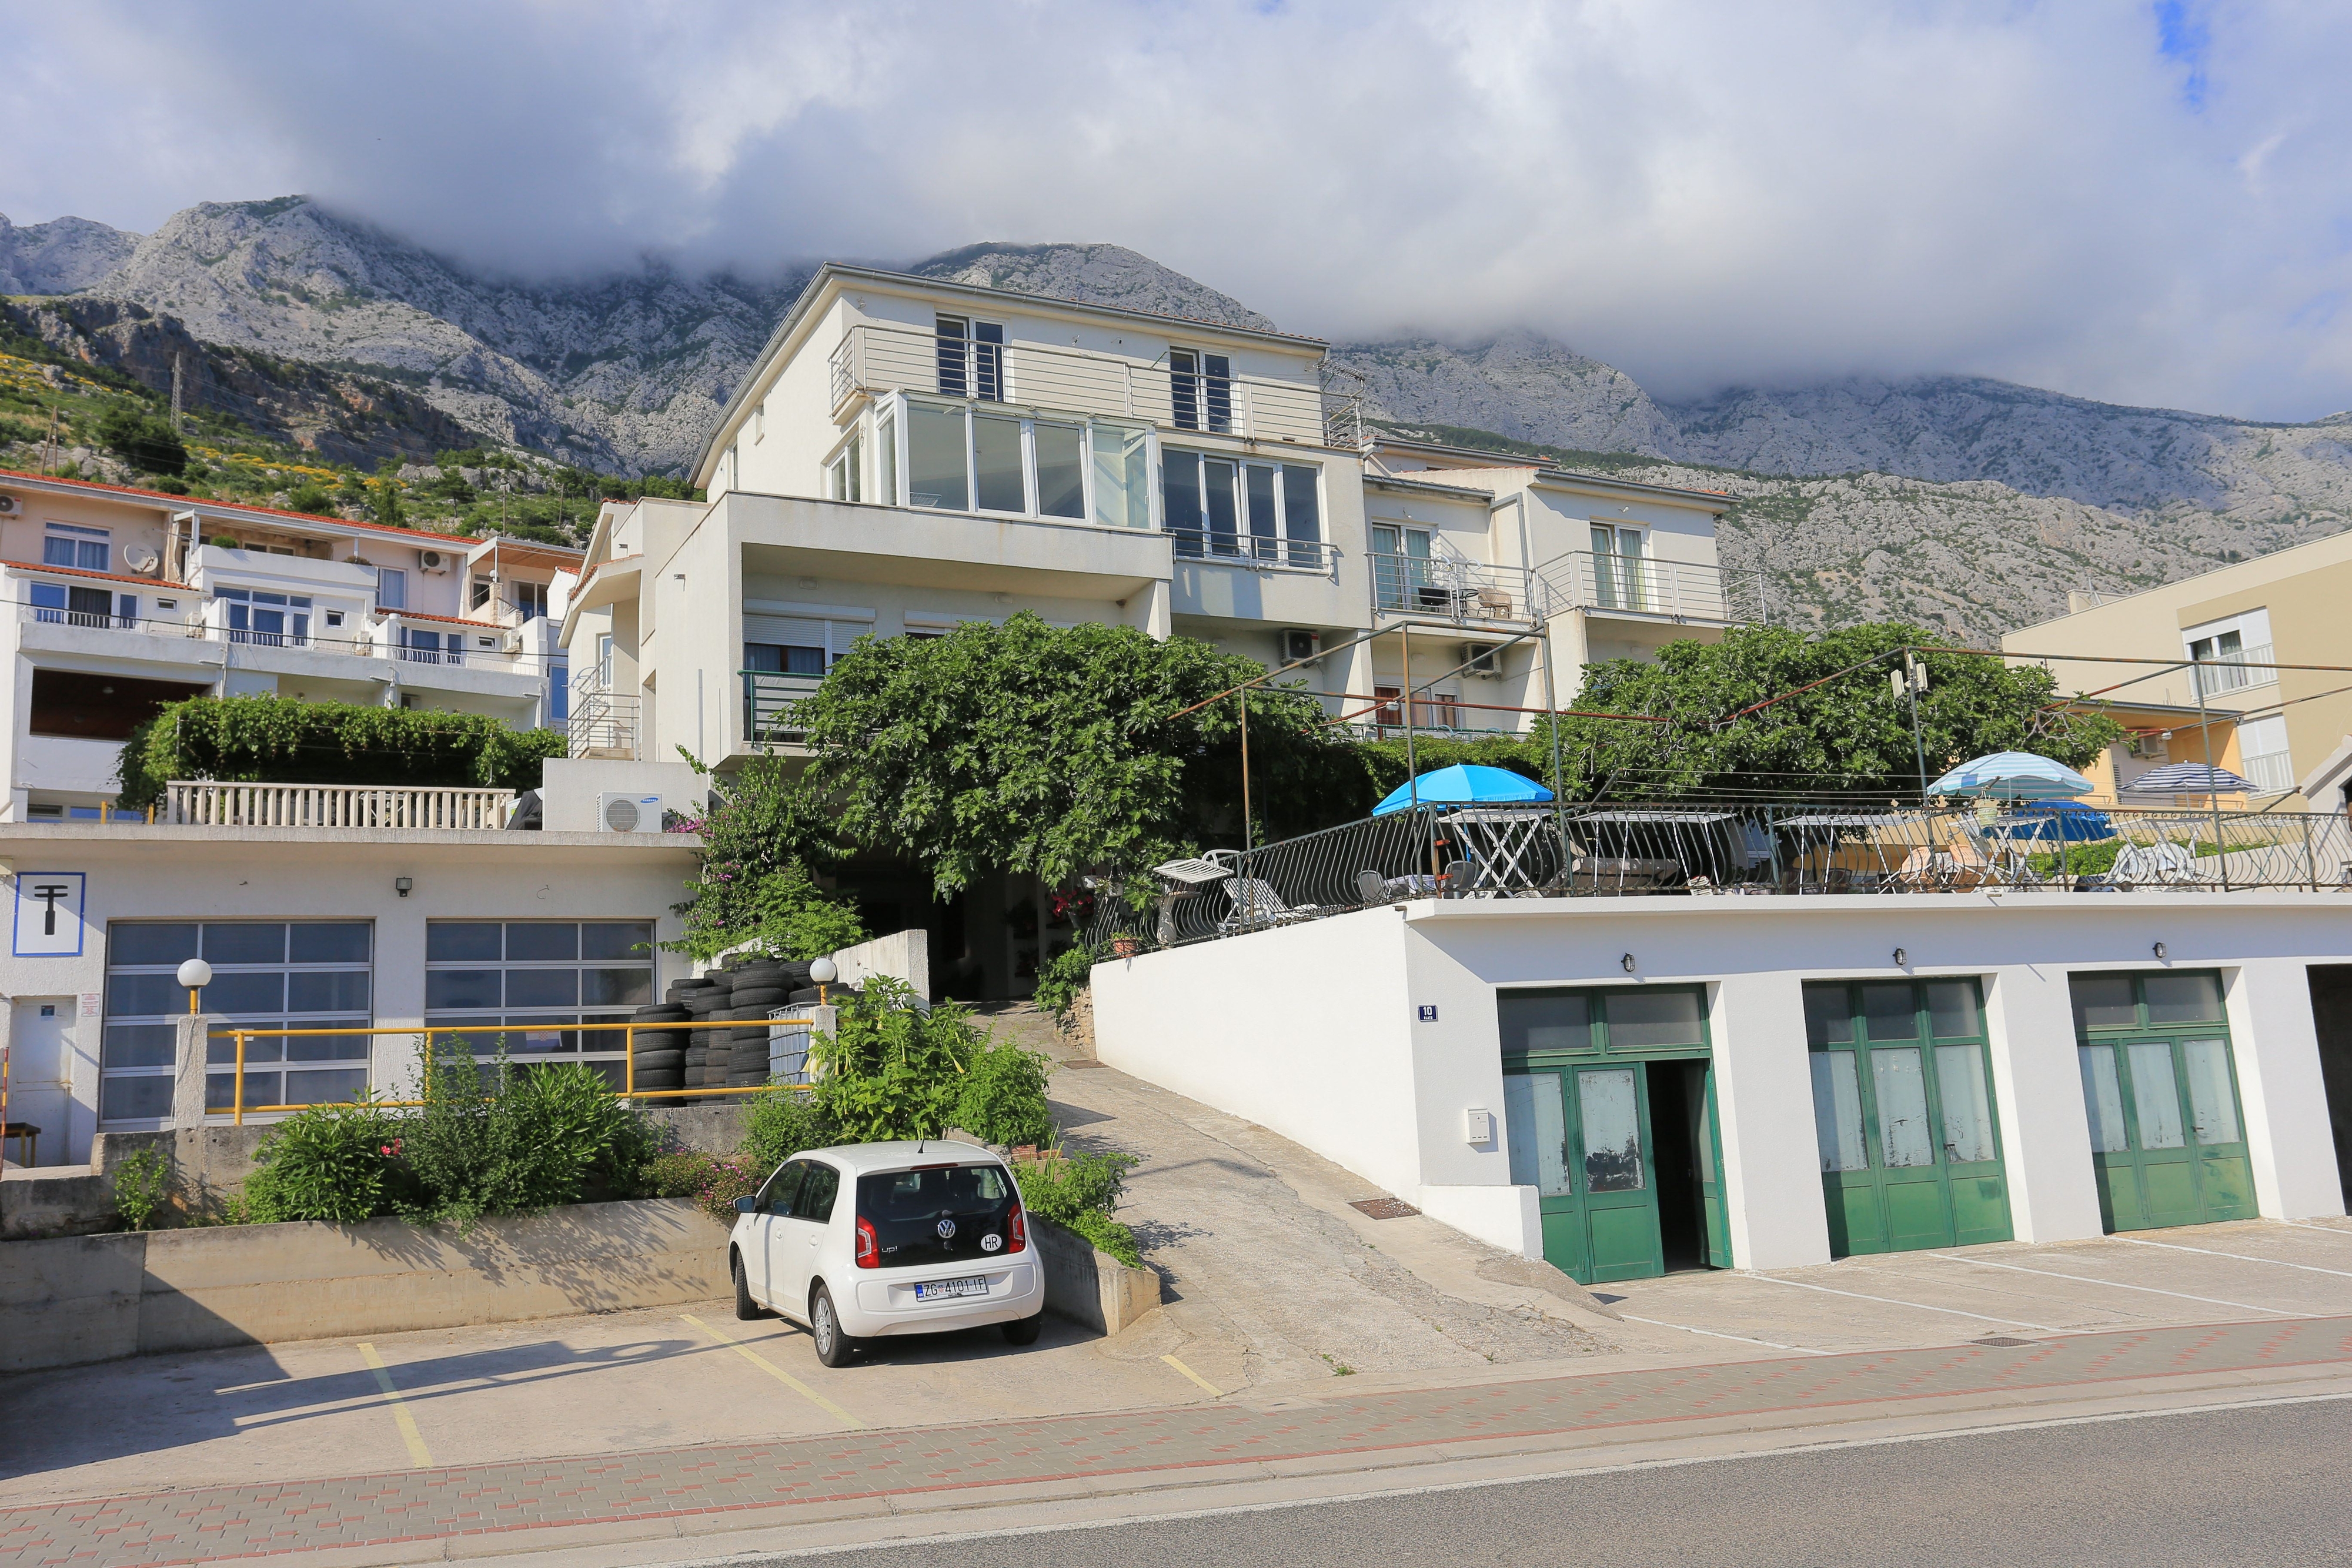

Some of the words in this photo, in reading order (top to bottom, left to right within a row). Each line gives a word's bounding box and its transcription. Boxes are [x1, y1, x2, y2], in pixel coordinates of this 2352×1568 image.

[1423, 1007, 1432, 1015] 10
[985, 1236, 998, 1249] HR
[881, 1245, 897, 1253] up!
[924, 1284, 938, 1296] ZG
